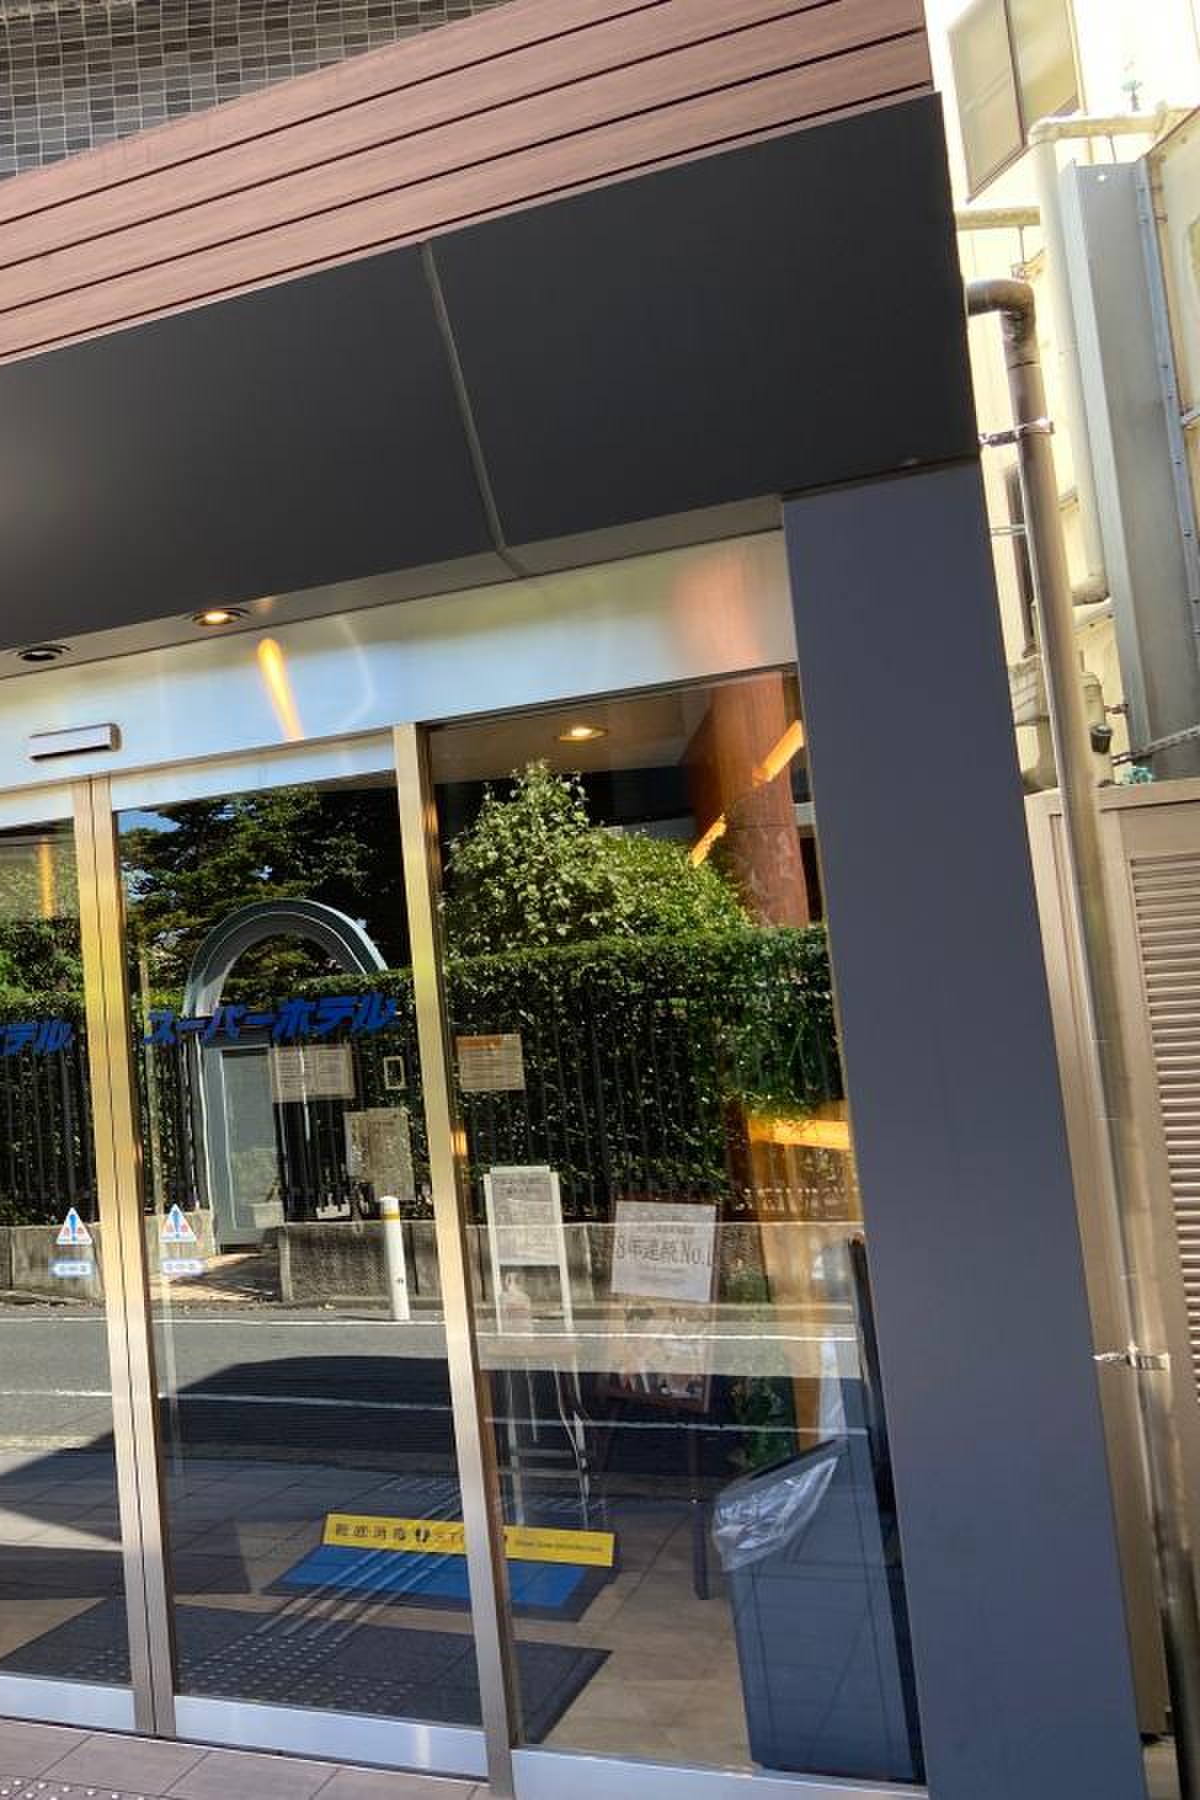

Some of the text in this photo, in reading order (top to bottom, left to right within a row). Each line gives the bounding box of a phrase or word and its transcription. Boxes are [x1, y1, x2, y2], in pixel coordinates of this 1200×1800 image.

[143, 992, 397, 1044] スーパーホテル
